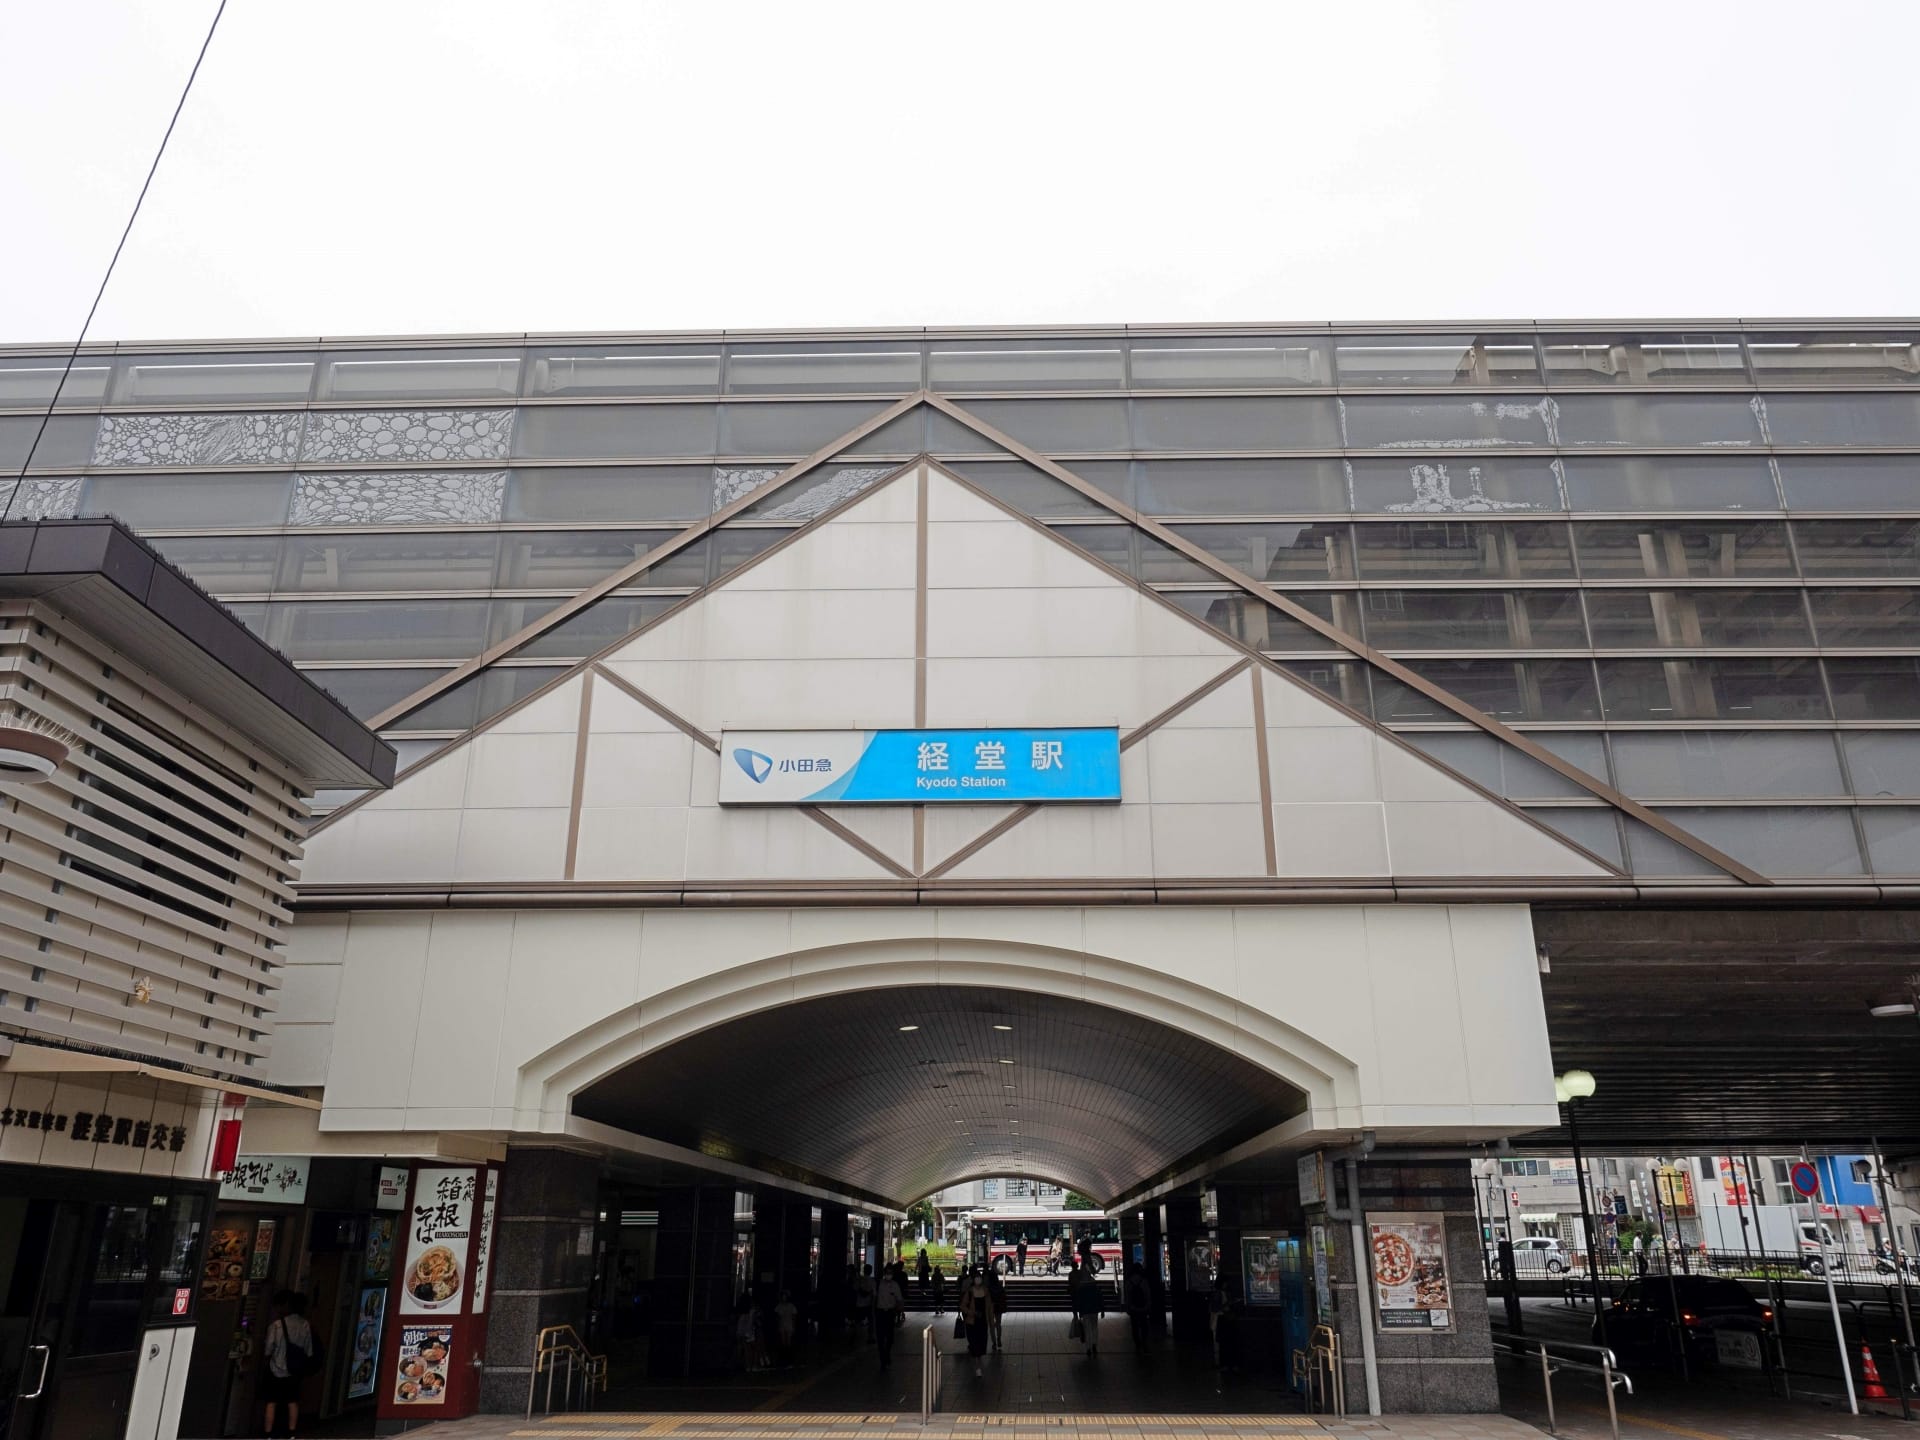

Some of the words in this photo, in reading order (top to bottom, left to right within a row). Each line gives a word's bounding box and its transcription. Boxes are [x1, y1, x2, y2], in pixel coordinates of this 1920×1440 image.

[779, 758, 832, 773] 小田急
[917, 741, 1063, 771] 経堂駅
[917, 776, 957, 789] Kyodo
[961, 776, 1006, 787] Station
[71, 1111, 187, 1152] 経堂駅前交番
